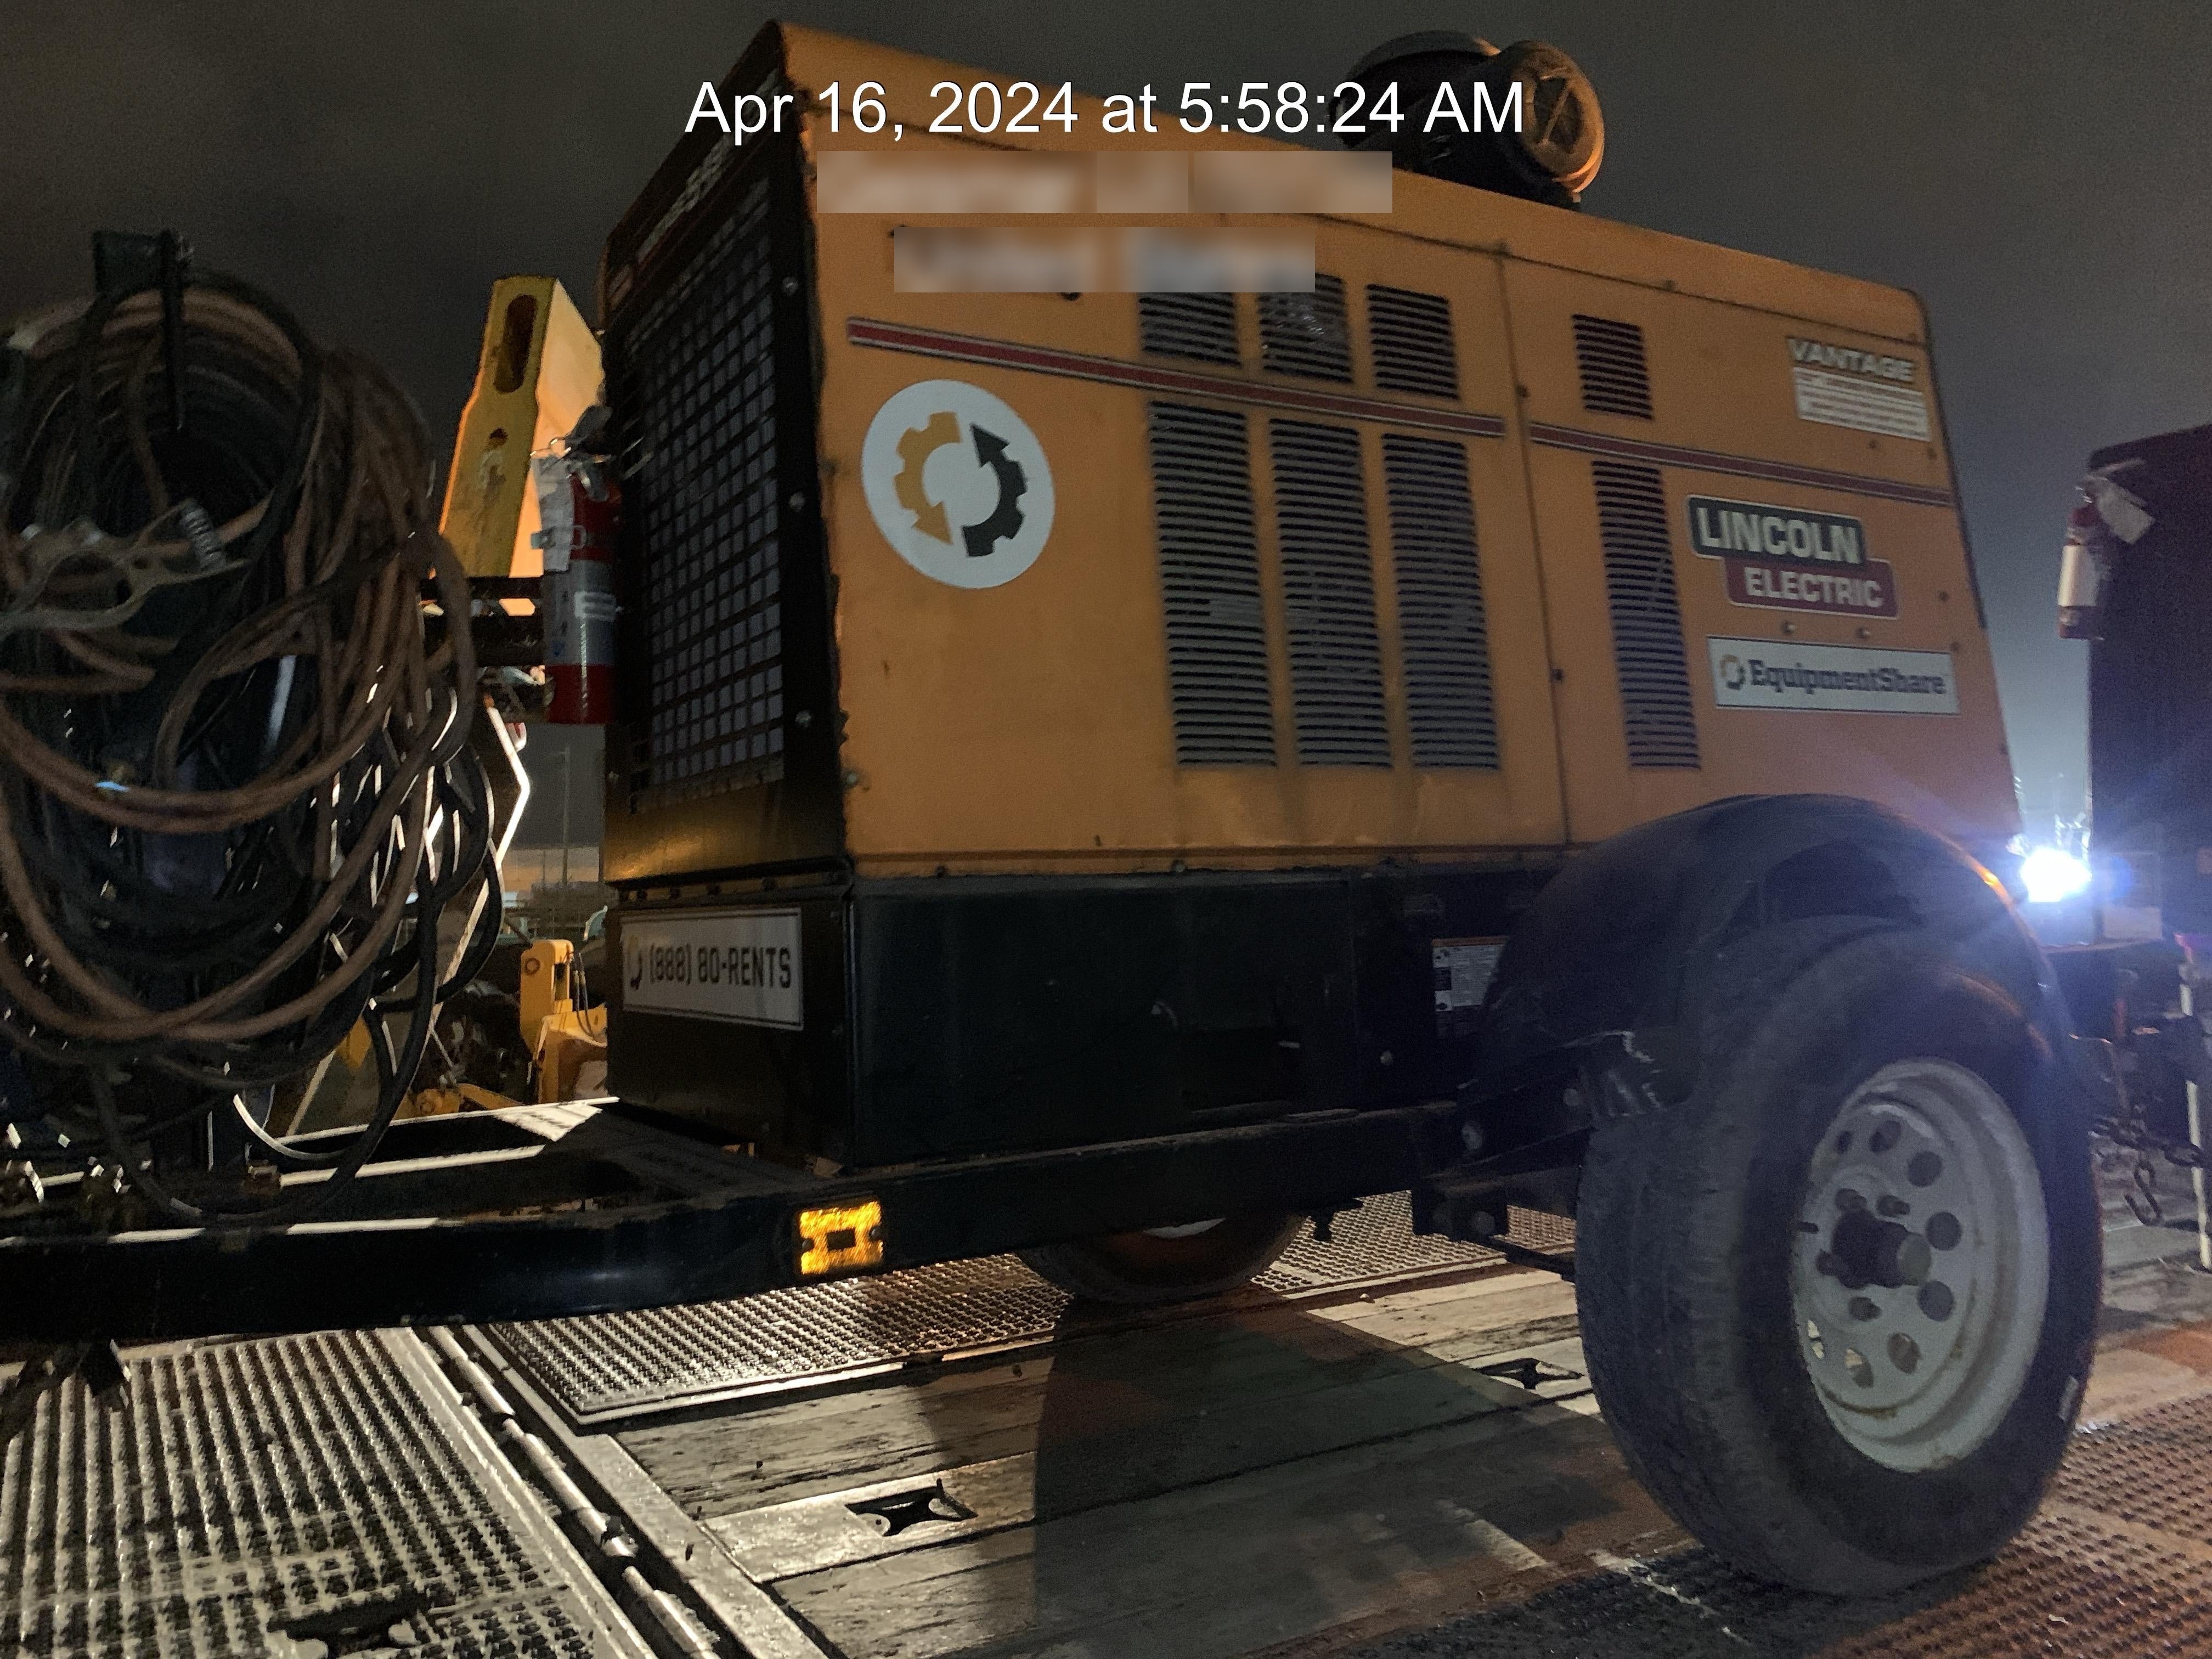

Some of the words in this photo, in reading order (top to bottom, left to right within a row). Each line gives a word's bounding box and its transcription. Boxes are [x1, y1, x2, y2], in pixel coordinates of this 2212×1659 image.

[1787, 337, 1914, 382] VANTAGE
[1696, 506, 1861, 565] LINCOLN
[1745, 567, 1884, 608] ELECTRIC
[1748, 659, 1946, 695] EquipmentShare
[698, 947, 791, 988] 80-RENTS
